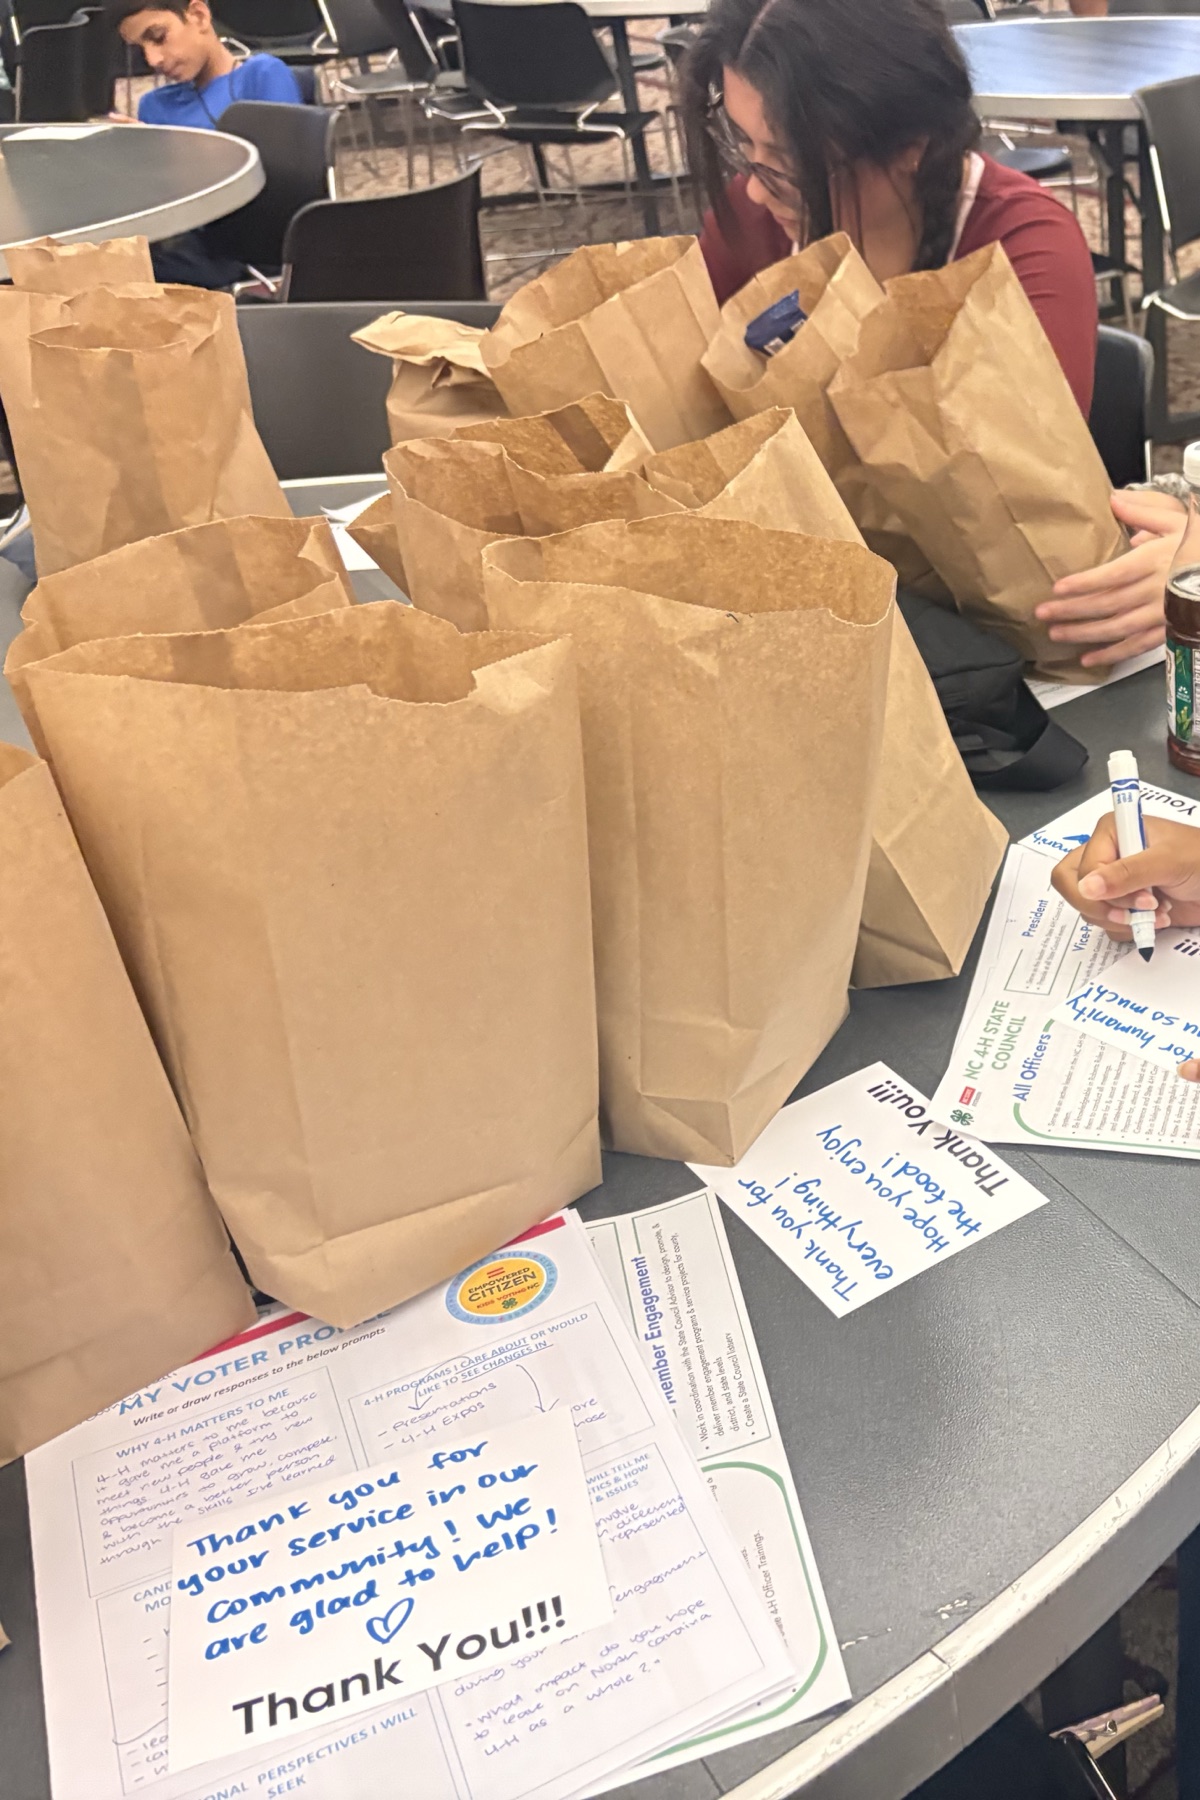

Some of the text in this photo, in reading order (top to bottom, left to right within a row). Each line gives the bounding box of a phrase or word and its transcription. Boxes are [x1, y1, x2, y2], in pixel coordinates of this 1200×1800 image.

[1022, 900, 1051, 940] President
[983, 1001, 1012, 1037] STATE
[1066, 995, 1158, 1048] humanity
[1081, 985, 1148, 1017] much!
[1152, 1012, 1179, 1025] so
[974, 1037, 994, 1058] 4-H
[990, 1015, 1029, 1072] COUNCIL
[963, 1060, 984, 1080] NC
[1013, 1035, 1051, 1101] All Officers
[867, 1078, 1012, 1199] Thank You!!!
[816, 1125, 952, 1252] Hope you enjoy
[948, 1200, 982, 1236] the
[738, 1180, 860, 1304] Thank you for
[468, 1267, 530, 1294] EMPOWERED
[468, 1271, 537, 1302] CITIZEN
[497, 1288, 526, 1301] VOTING
[631, 1257, 663, 1341] Engagement
[364, 1314, 587, 1405] 4-H PROGRAMS CARE ABOUT OR WOULD
[667, 1284, 708, 1442] Work in coordination with the State Council Advisor
[674, 1255, 724, 1436] deliver member engagement programs service projects for
[713, 1357, 725, 1376] levels
[120, 1388, 161, 1415] MY
[172, 1351, 269, 1392] VOTER
[134, 1412, 164, 1426] Write
[167, 1406, 179, 1414] or
[182, 1394, 211, 1409] draw
[214, 1372, 268, 1397] responses
[287, 1359, 303, 1369] the
[307, 1346, 339, 1361] below
[342, 1328, 385, 1350] prompts
[415, 1340, 549, 1397] LIKE TO SEE CHANGES IN
[720, 1376, 729, 1391] state
[726, 1333, 754, 1427] Create State Council listserv
[203, 1433, 219, 1441] to
[226, 1419, 249, 1432] me
[262, 1392, 317, 1417] because
[393, 1383, 496, 1431] Presentations
[443, 1402, 484, 1425] Expos
[721, 1392, 733, 1405] and
[116, 1389, 289, 1458] WHY 4-H MATTERS TO ME
[119, 1410, 298, 1486] gave me platform to
[140, 1474, 171, 1491] new
[178, 1454, 223, 1476] people
[285, 1417, 312, 1431] new
[200, 1463, 233, 1480] gave
[241, 1449, 267, 1462] me
[586, 1454, 649, 1484] WILL TELL ME
[606, 1479, 638, 1498] ISSUES
[624, 1464, 648, 1479] HOW
[120, 1510, 175, 1536] become
[266, 1454, 319, 1480] person
[187, 1442, 487, 1559] Thank you for
[178, 1465, 538, 1599] your service in our
[754, 1533, 767, 1569] Trainings.
[762, 1570, 774, 1598] Officer
[205, 1621, 267, 1660] are
[290, 1578, 382, 1637] glad
[399, 1568, 435, 1586] to
[511, 1647, 547, 1668] your
[600, 1644, 619, 1657] do
[630, 1625, 661, 1643] you
[233, 1596, 565, 1734] Thank You!!!
[556, 1683, 579, 1697] on
[258, 1708, 417, 1787] PERSPECTIVES WILL
[529, 1719, 547, 1732] as
[268, 1773, 305, 1799] SEEK
